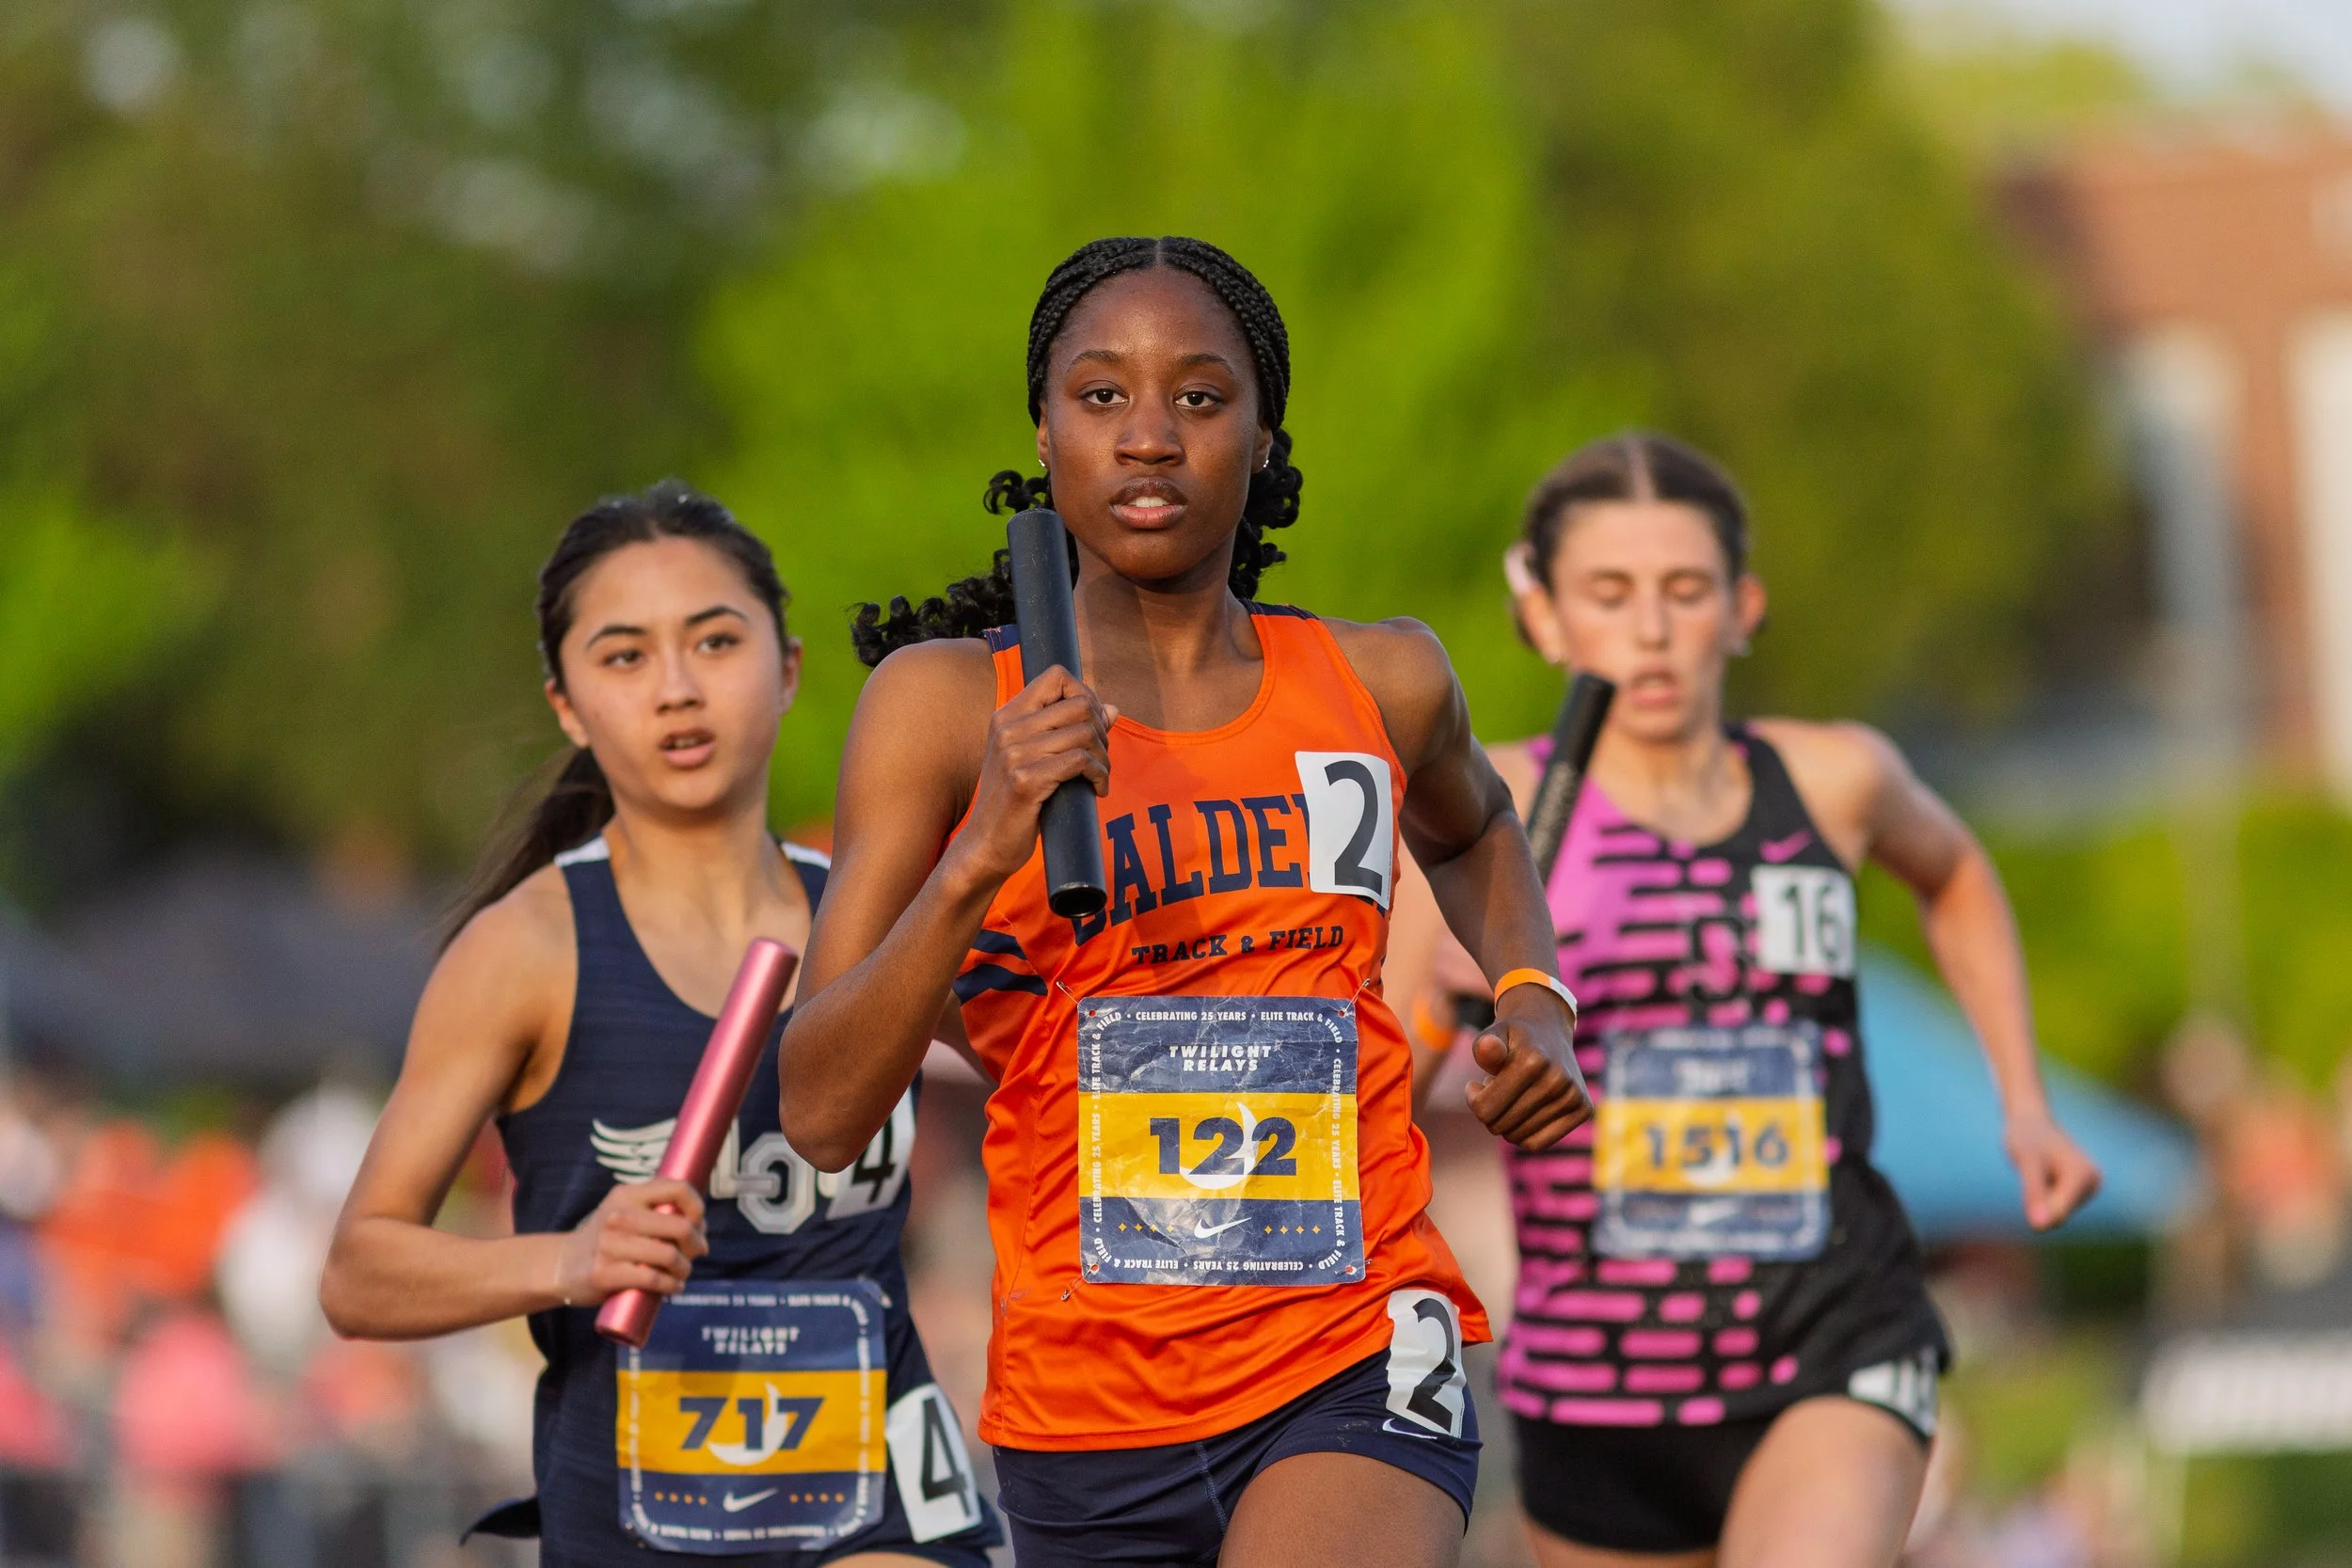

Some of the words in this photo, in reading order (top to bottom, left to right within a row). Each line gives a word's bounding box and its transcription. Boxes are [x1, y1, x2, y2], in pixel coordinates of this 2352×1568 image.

[1324, 759, 1383, 895] 2
[1782, 884, 1840, 961] 16
[1131, 934, 1228, 966] TRACK
[1240, 936, 1255, 954] &
[1269, 926, 1344, 951] FIELD
[1096, 1012, 1122, 1031] FIELD
[1136, 1011, 1198, 1021] CELEBRATING
[1216, 1011, 1247, 1021] YEARS
[1261, 1011, 1283, 1021] ELITE
[1286, 1011, 1314, 1022] TRACK
[1325, 1019, 1343, 1043] FIELD
[1091, 1043, 1101, 1074] TRACK
[1168, 1045, 1272, 1058] TWILIGHT
[1183, 1059, 1258, 1071] RELAYS
[1092, 1076, 1101, 1100] ELITE
[1332, 1058, 1343, 1119] CELEBRATING
[1092, 1113, 1101, 1142] YEARS
[850, 1110, 897, 1204] 4
[1150, 1117, 1297, 1176] 122
[1331, 1139, 1342, 1169] YEARS
[1645, 1121, 1790, 1170] 1516
[1092, 1162, 1102, 1223] CELEBRATING
[1333, 1180, 1343, 1203] ELITE
[1334, 1206, 1344, 1236] TRACK
[1094, 1238, 1112, 1263] FIELD
[1124, 1259, 1152, 1269] TRACK
[1155, 1259, 1179, 1269] ELITE
[1193, 1260, 1223, 1270] YEARS
[1318, 1249, 1343, 1270] FIELD
[1243, 1261, 1304, 1271] CELEBRATING
[702, 1326, 800, 1341] TWILIGHT
[1406, 1298, 1456, 1433] 2
[679, 1396, 825, 1451] 717
[920, 1396, 973, 1518] 4
